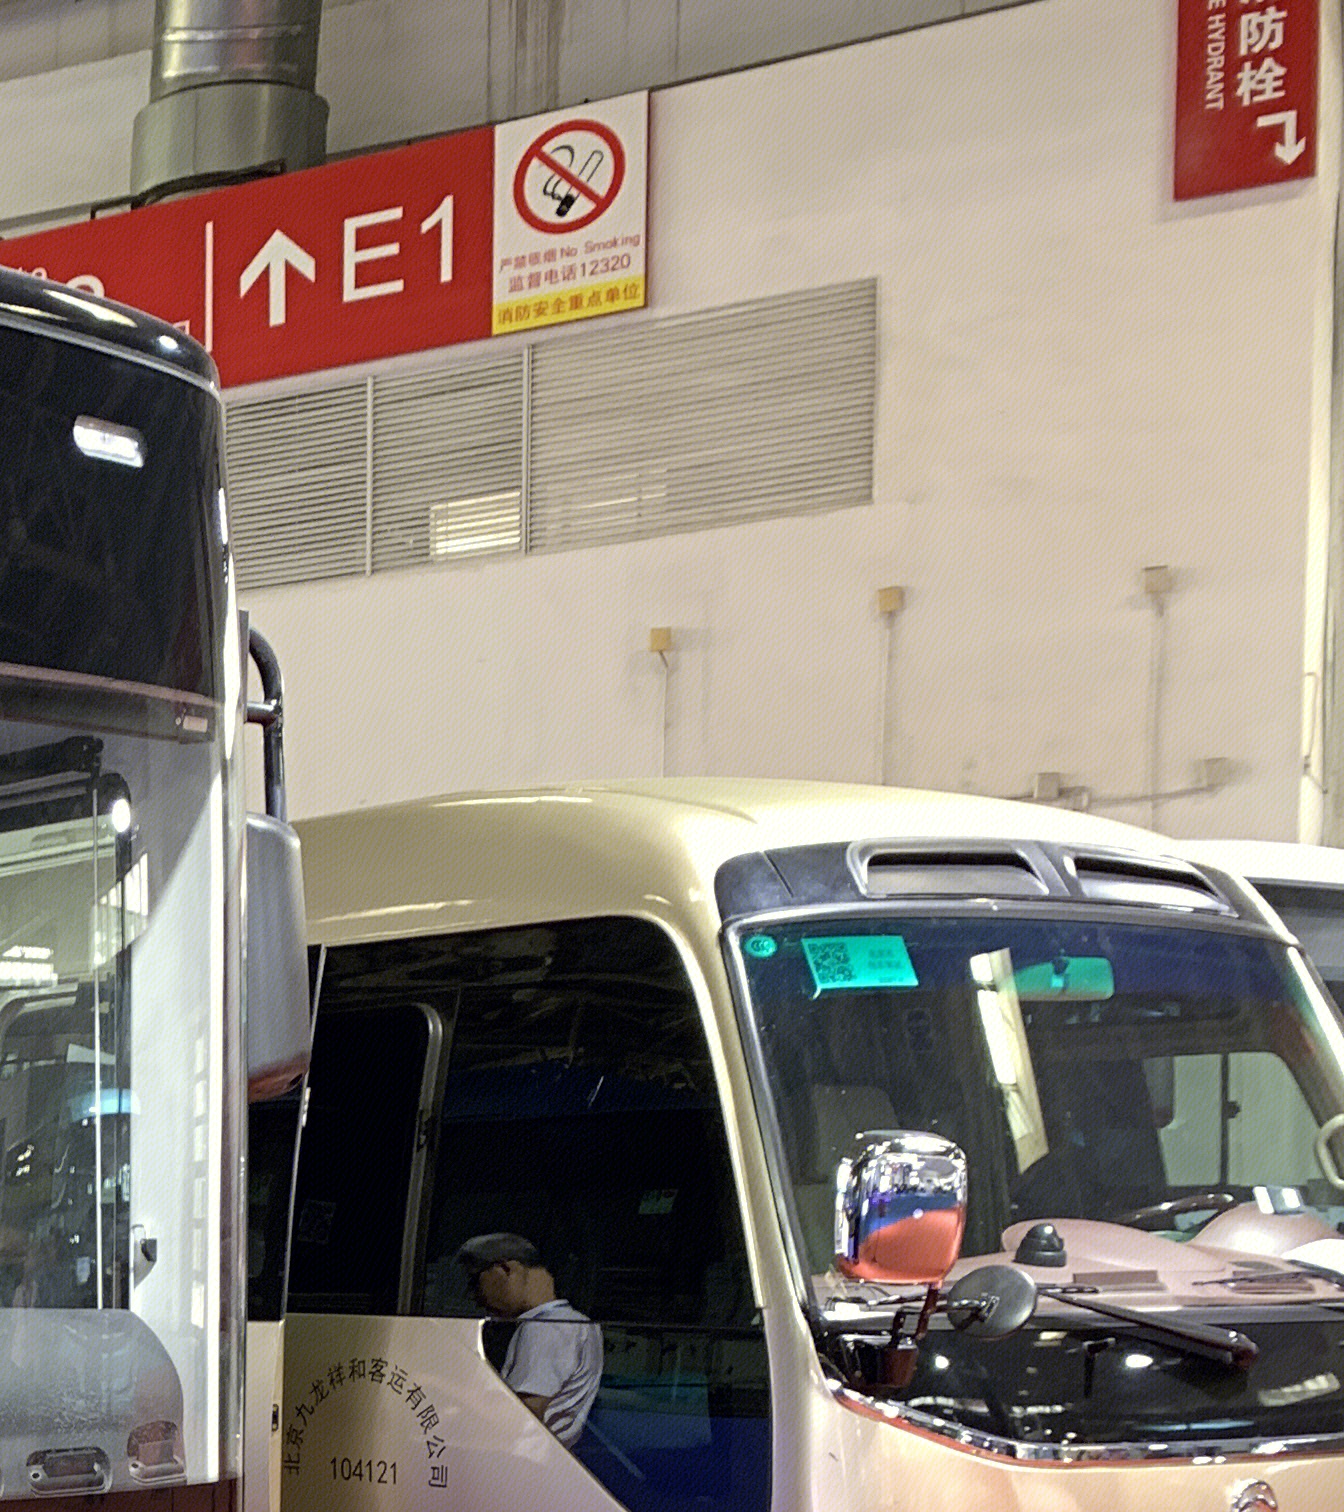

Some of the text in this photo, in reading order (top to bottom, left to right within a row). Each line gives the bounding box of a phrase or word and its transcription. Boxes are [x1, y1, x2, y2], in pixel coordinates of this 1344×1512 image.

[1205, 13, 1226, 110] HYDRANT
[1235, 0, 1288, 107] 防栓
[342, 194, 454, 303] E1
[584, 233, 641, 254] Smoking
[498, 282, 639, 325] 消防安全重点单位
[283, 1357, 448, 1488] 北京九龙祥和客运有限公司
[330, 1457, 397, 1484] 104121
